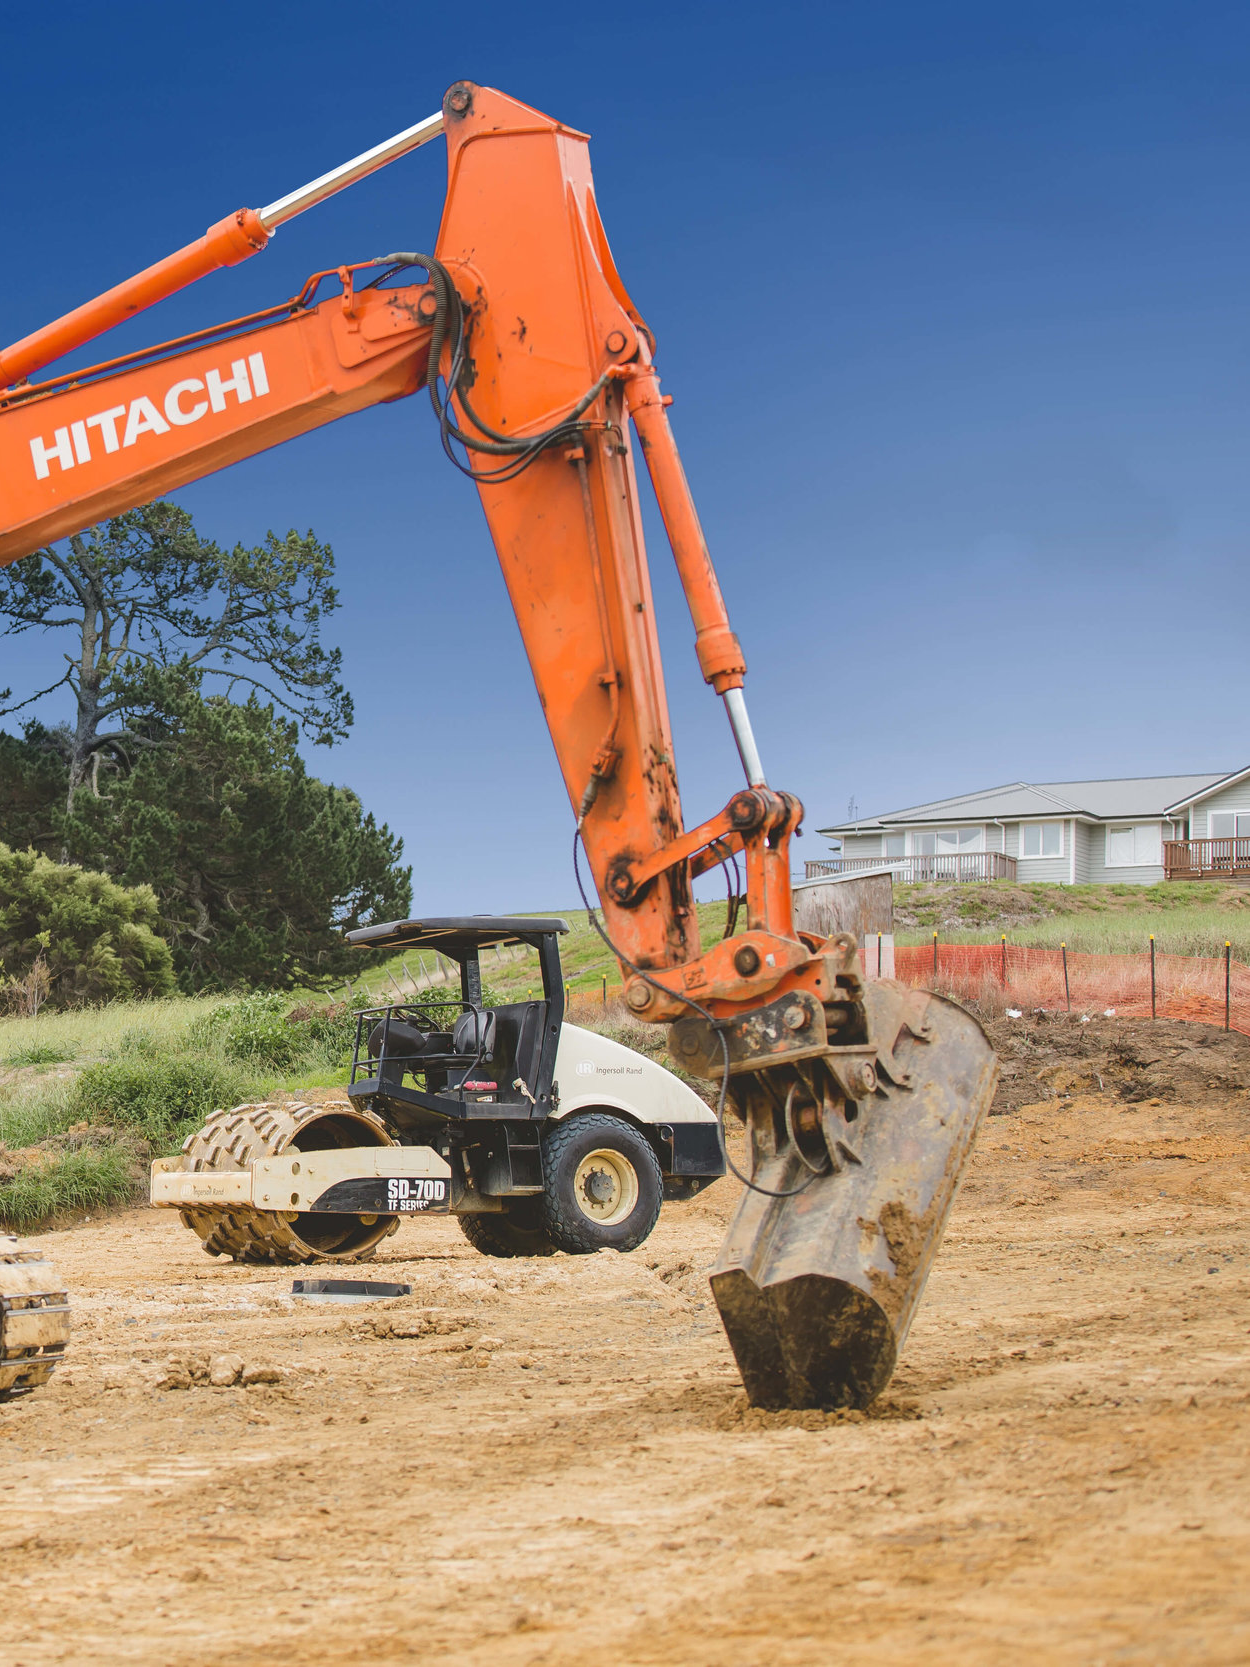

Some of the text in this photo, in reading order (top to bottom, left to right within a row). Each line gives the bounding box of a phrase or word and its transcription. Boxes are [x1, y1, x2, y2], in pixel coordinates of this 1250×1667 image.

[30, 352, 270, 480] HITACHI
[596, 1067, 625, 1076] Ingersoll
[626, 1067, 643, 1075] Rand
[387, 1179, 446, 1201] SD-70D
[387, 1200, 398, 1211] TF
